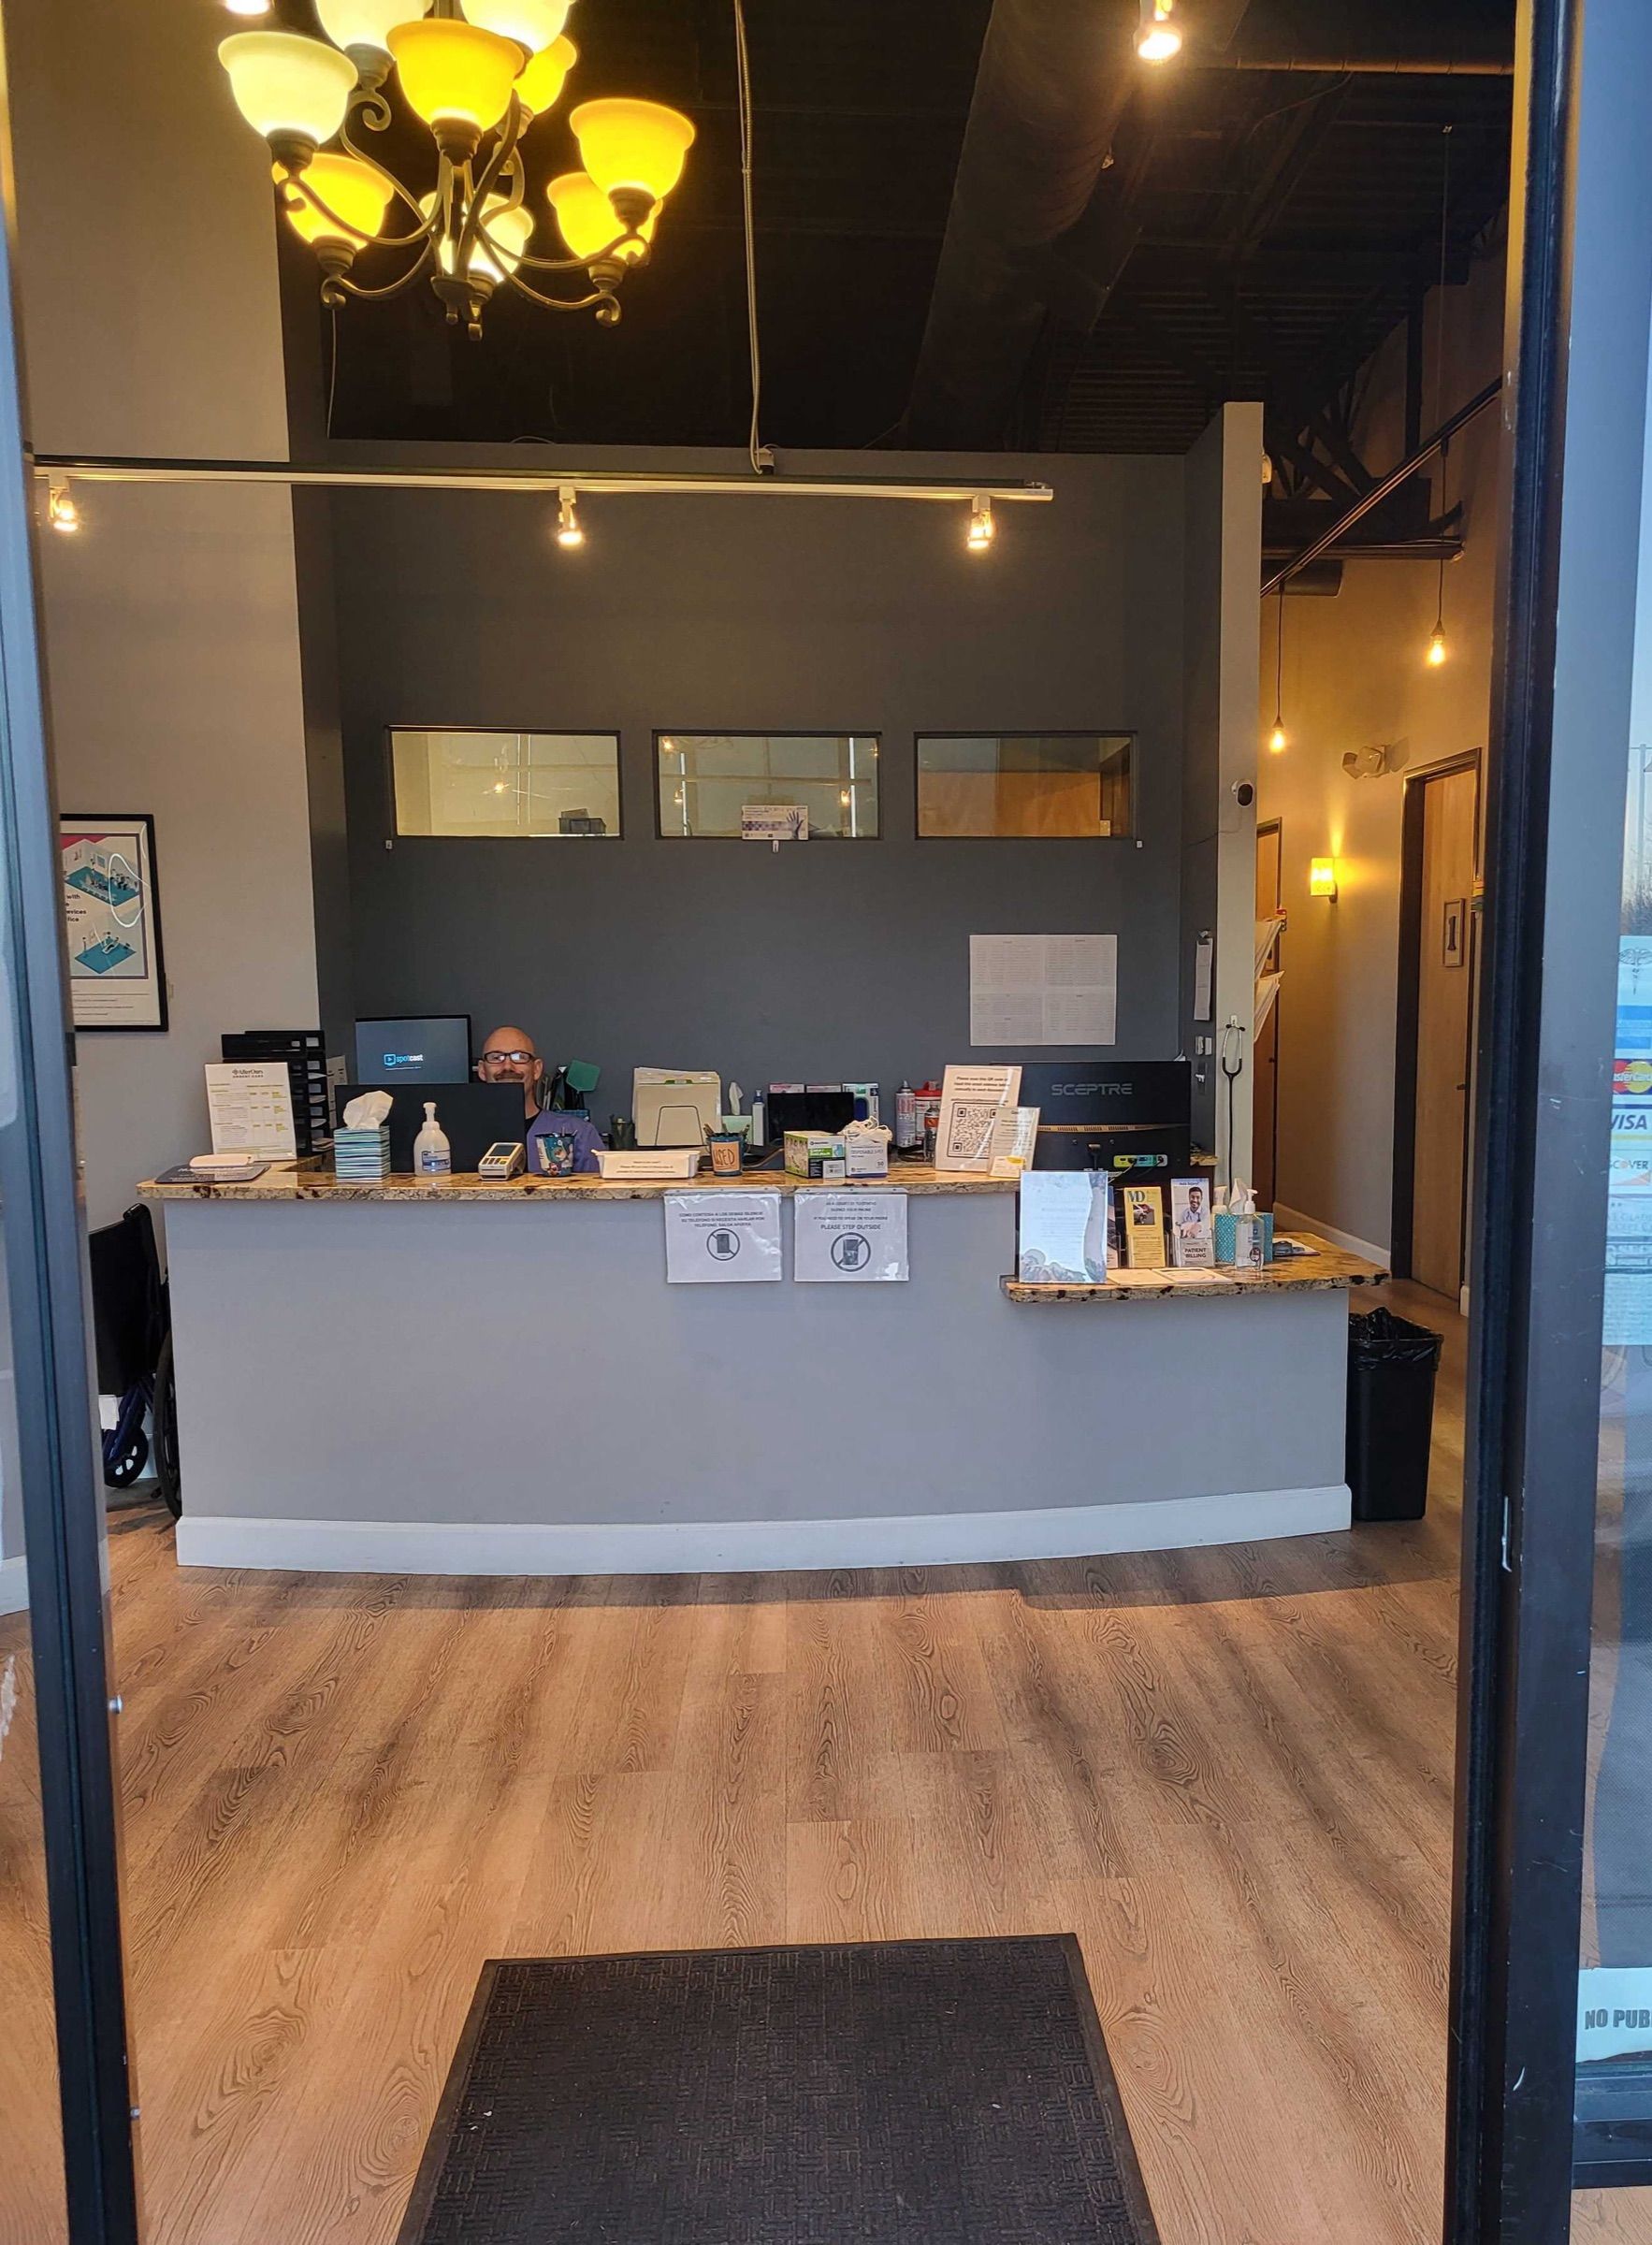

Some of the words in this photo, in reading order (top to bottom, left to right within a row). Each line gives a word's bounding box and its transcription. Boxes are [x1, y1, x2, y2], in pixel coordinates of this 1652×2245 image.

[1051, 1083, 1133, 1095] SCEPTRE
[714, 1149, 735, 1166] USED
[1610, 1160, 1648, 1169] COVER
[1585, 2008, 1608, 2030] NO
[1613, 2009, 1652, 2029] PUB
